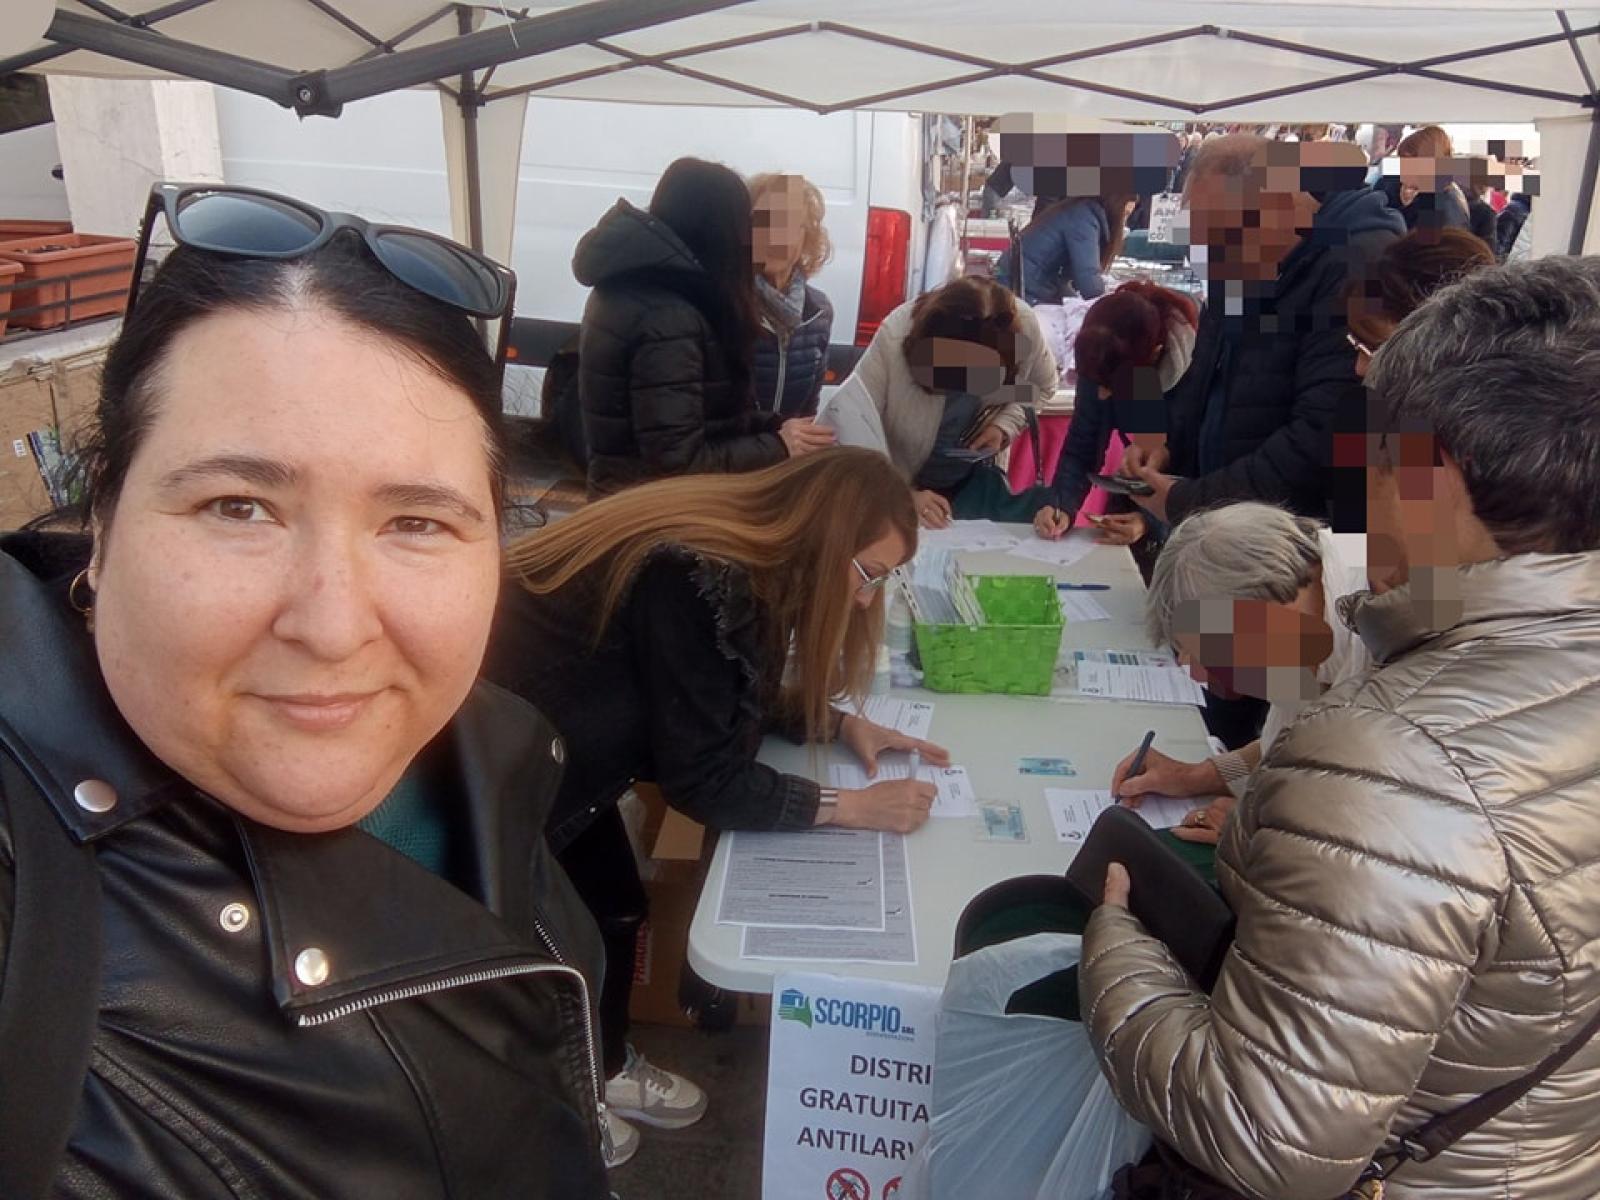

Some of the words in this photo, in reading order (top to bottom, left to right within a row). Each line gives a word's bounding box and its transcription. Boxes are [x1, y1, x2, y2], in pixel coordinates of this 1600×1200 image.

[814, 997, 901, 1033] SCORPIO
[850, 1054, 932, 1086] DISTRI
[799, 1087, 930, 1123] GRATUITA
